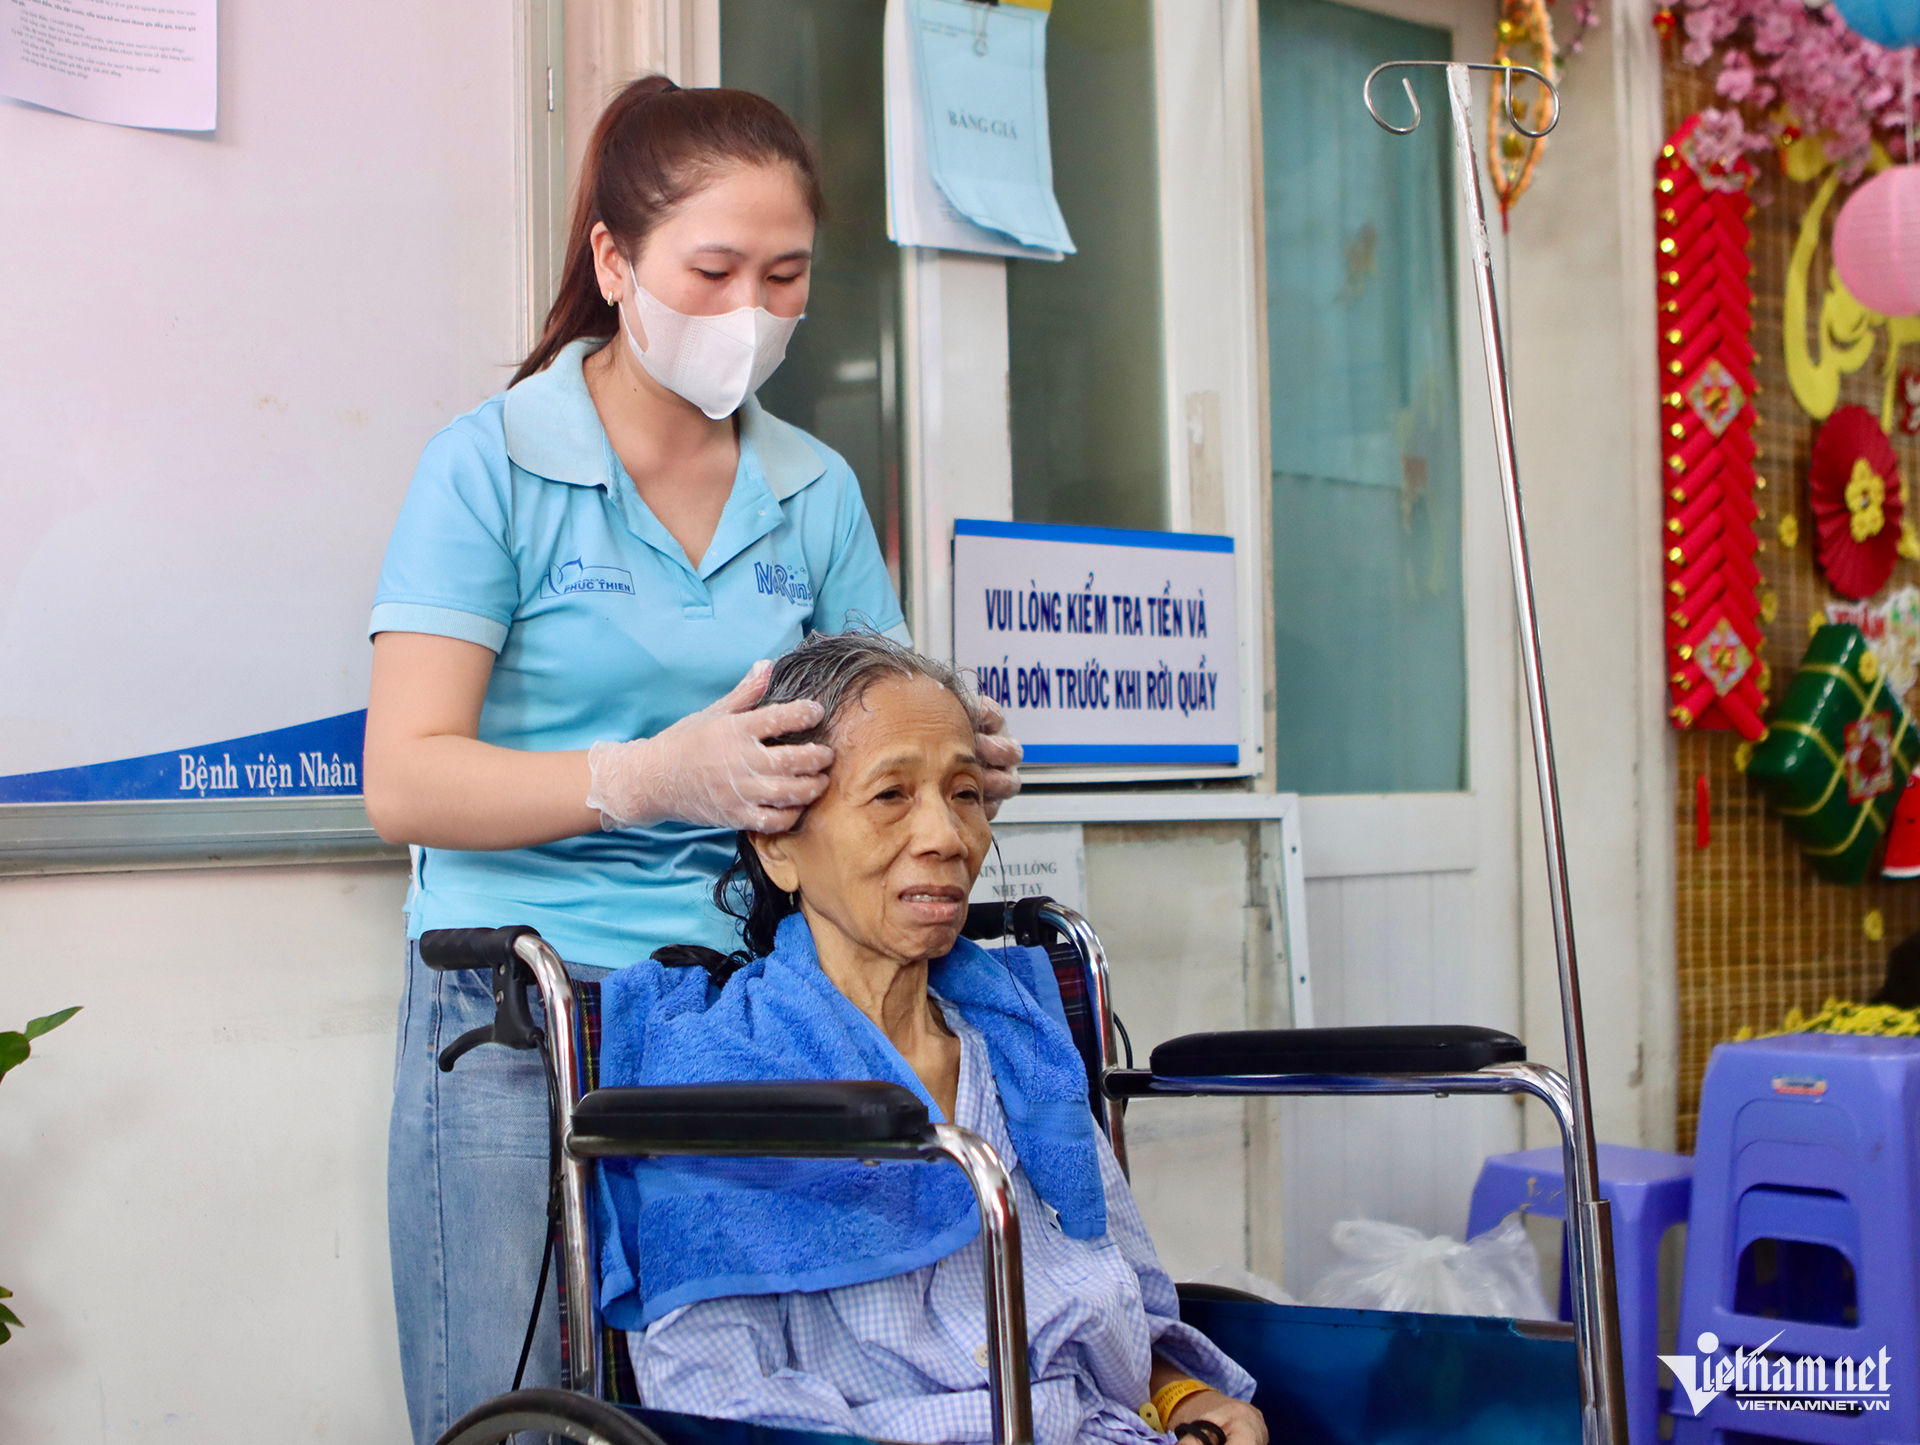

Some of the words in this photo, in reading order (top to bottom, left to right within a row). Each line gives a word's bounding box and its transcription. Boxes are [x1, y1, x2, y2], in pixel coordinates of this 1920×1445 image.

[991, 120, 1017, 140] GIÁ
[599, 581, 631, 592] THIEN
[985, 589, 1012, 631] VUI
[1019, 579, 1062, 633] LÒNG
[1067, 572, 1108, 634] KIỂM
[1112, 595, 1144, 636] TRA
[1147, 580, 1183, 637] TIỀN
[1187, 589, 1207, 638] VÀ
[977, 655, 1012, 708] HOÁ
[1017, 661, 1050, 708] ĐƠN
[1056, 658, 1110, 709] TRƯỚC
[1115, 670, 1141, 710] KHI
[1147, 660, 1173, 710] RỜI
[1177, 654, 1218, 718] QUẦY
[179, 753, 239, 797] Bệnh
[245, 753, 293, 796] viện
[299, 752, 357, 788] Nhân
[1024, 860, 1057, 876] LÒNG
[1020, 882, 1043, 896] TAY
